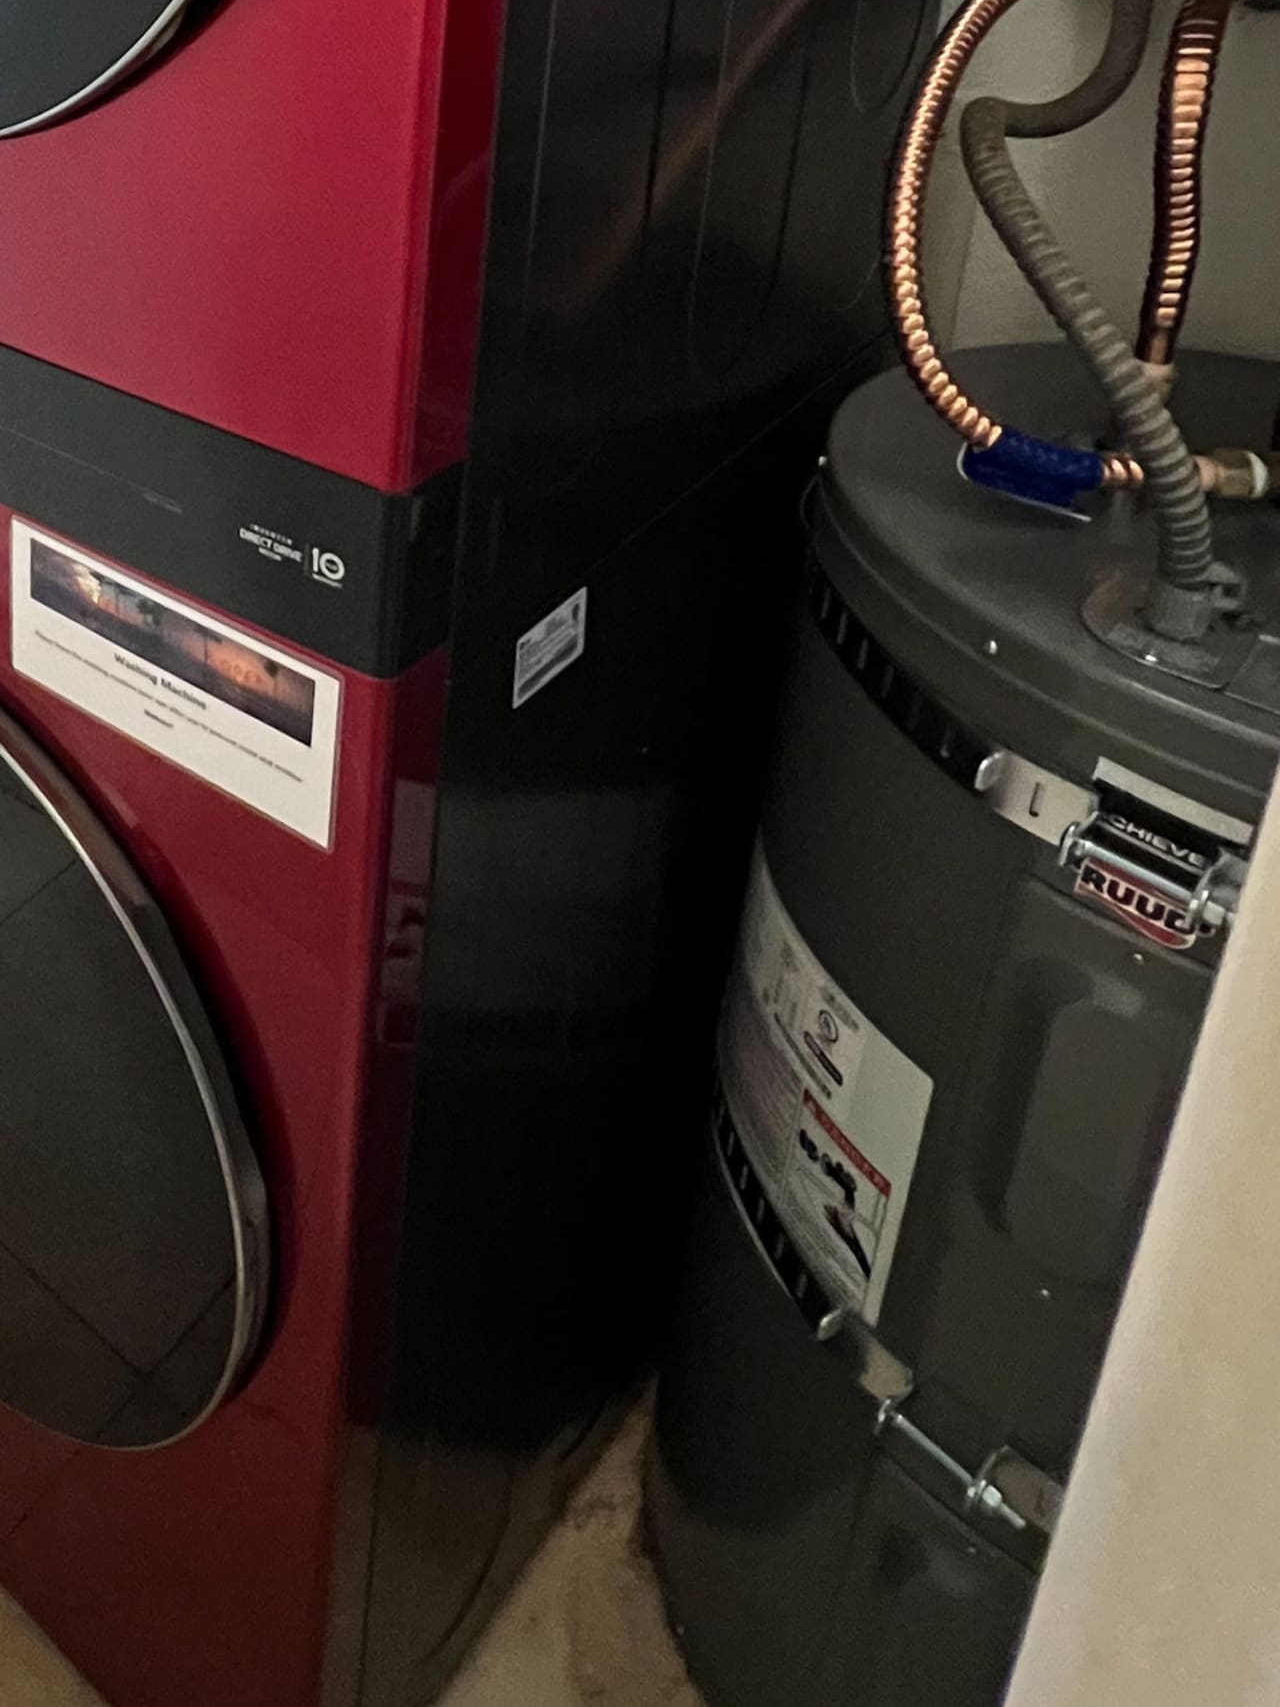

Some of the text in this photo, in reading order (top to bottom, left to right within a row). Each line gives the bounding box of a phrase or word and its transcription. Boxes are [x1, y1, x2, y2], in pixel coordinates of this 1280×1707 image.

[114, 652, 158, 686] Washing
[160, 677, 207, 710] Machine
[1103, 813, 1208, 871] CHIEVE
